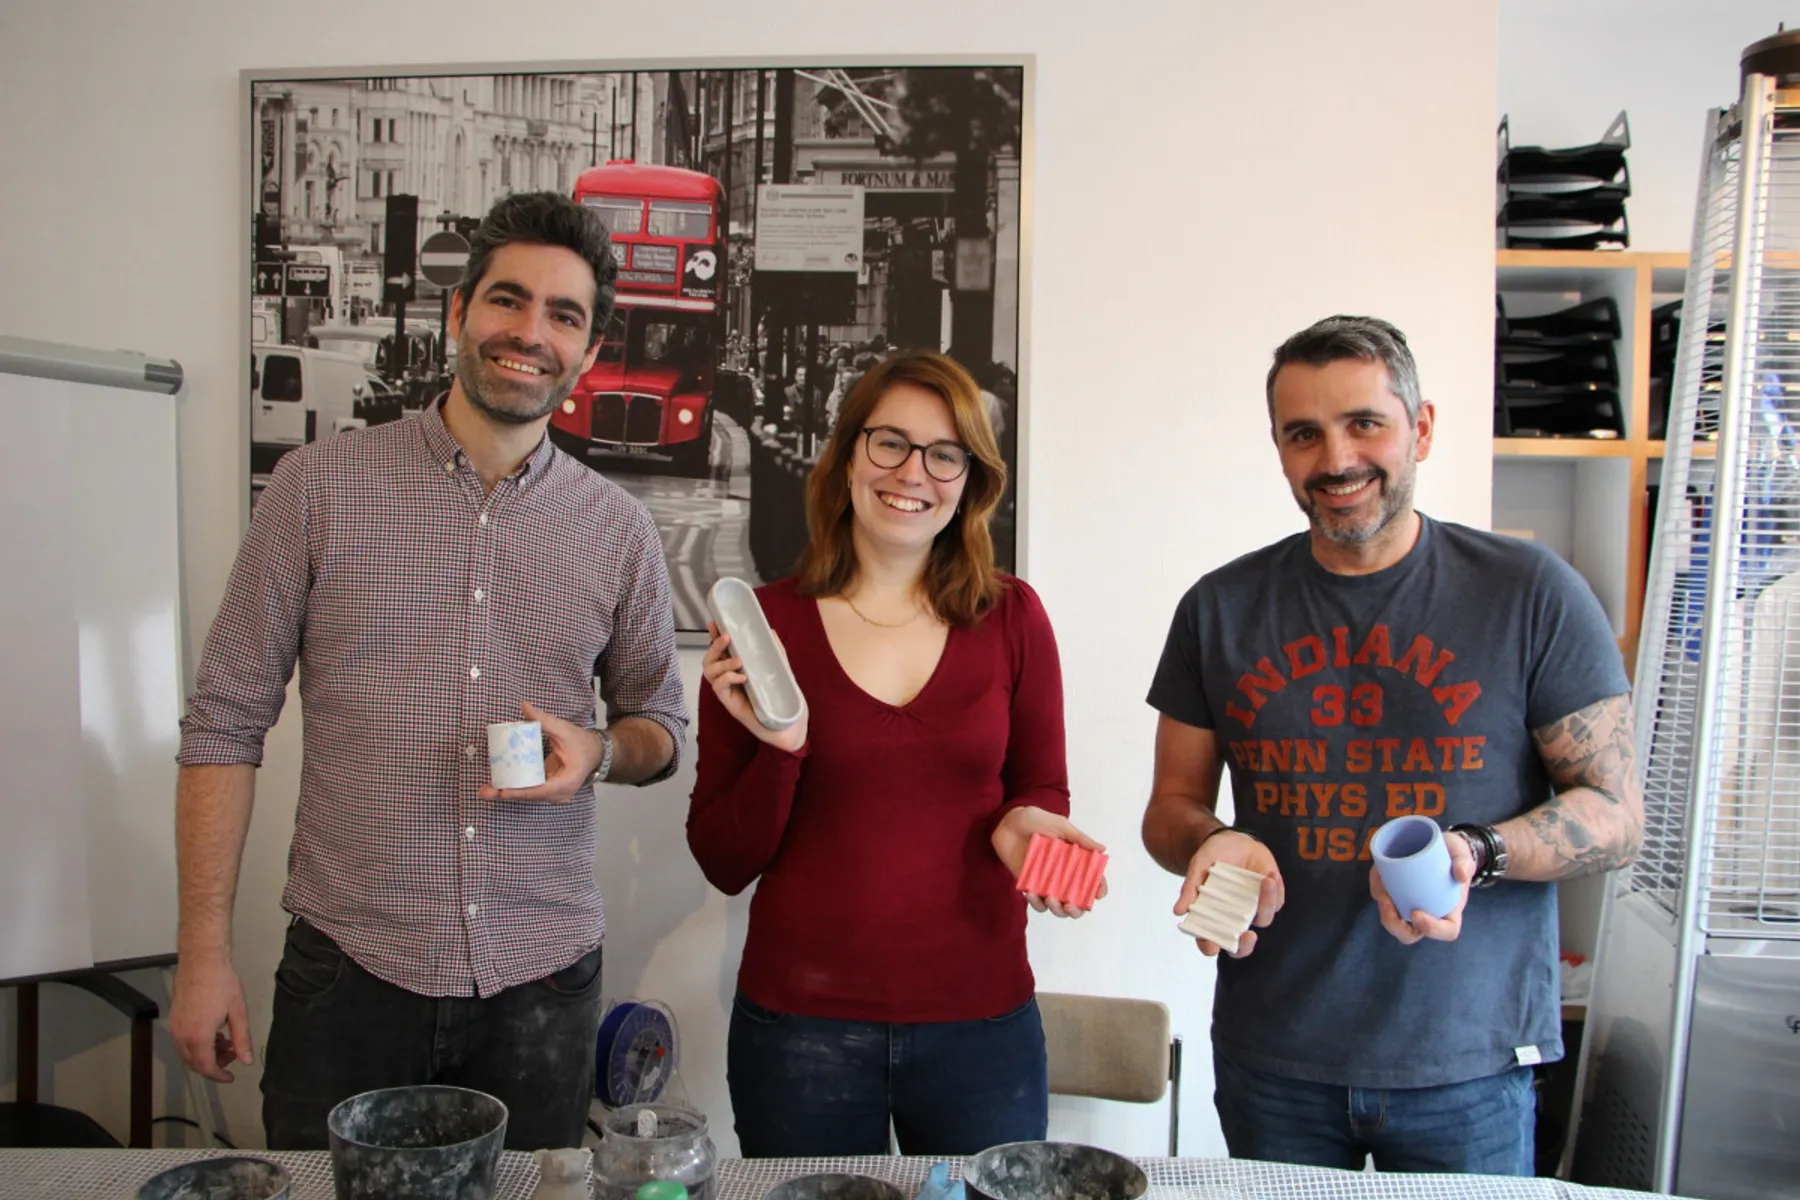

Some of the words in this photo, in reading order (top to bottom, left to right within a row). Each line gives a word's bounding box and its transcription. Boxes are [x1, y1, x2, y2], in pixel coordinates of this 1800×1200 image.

[841, 171, 906, 188] FORTNUM
[1226, 624, 1482, 729] INDIANA
[1310, 683, 1384, 727] 33
[1346, 736, 1486, 773] STATE
[1254, 782, 1367, 817] PHYS
[1385, 782, 1445, 817] ED
